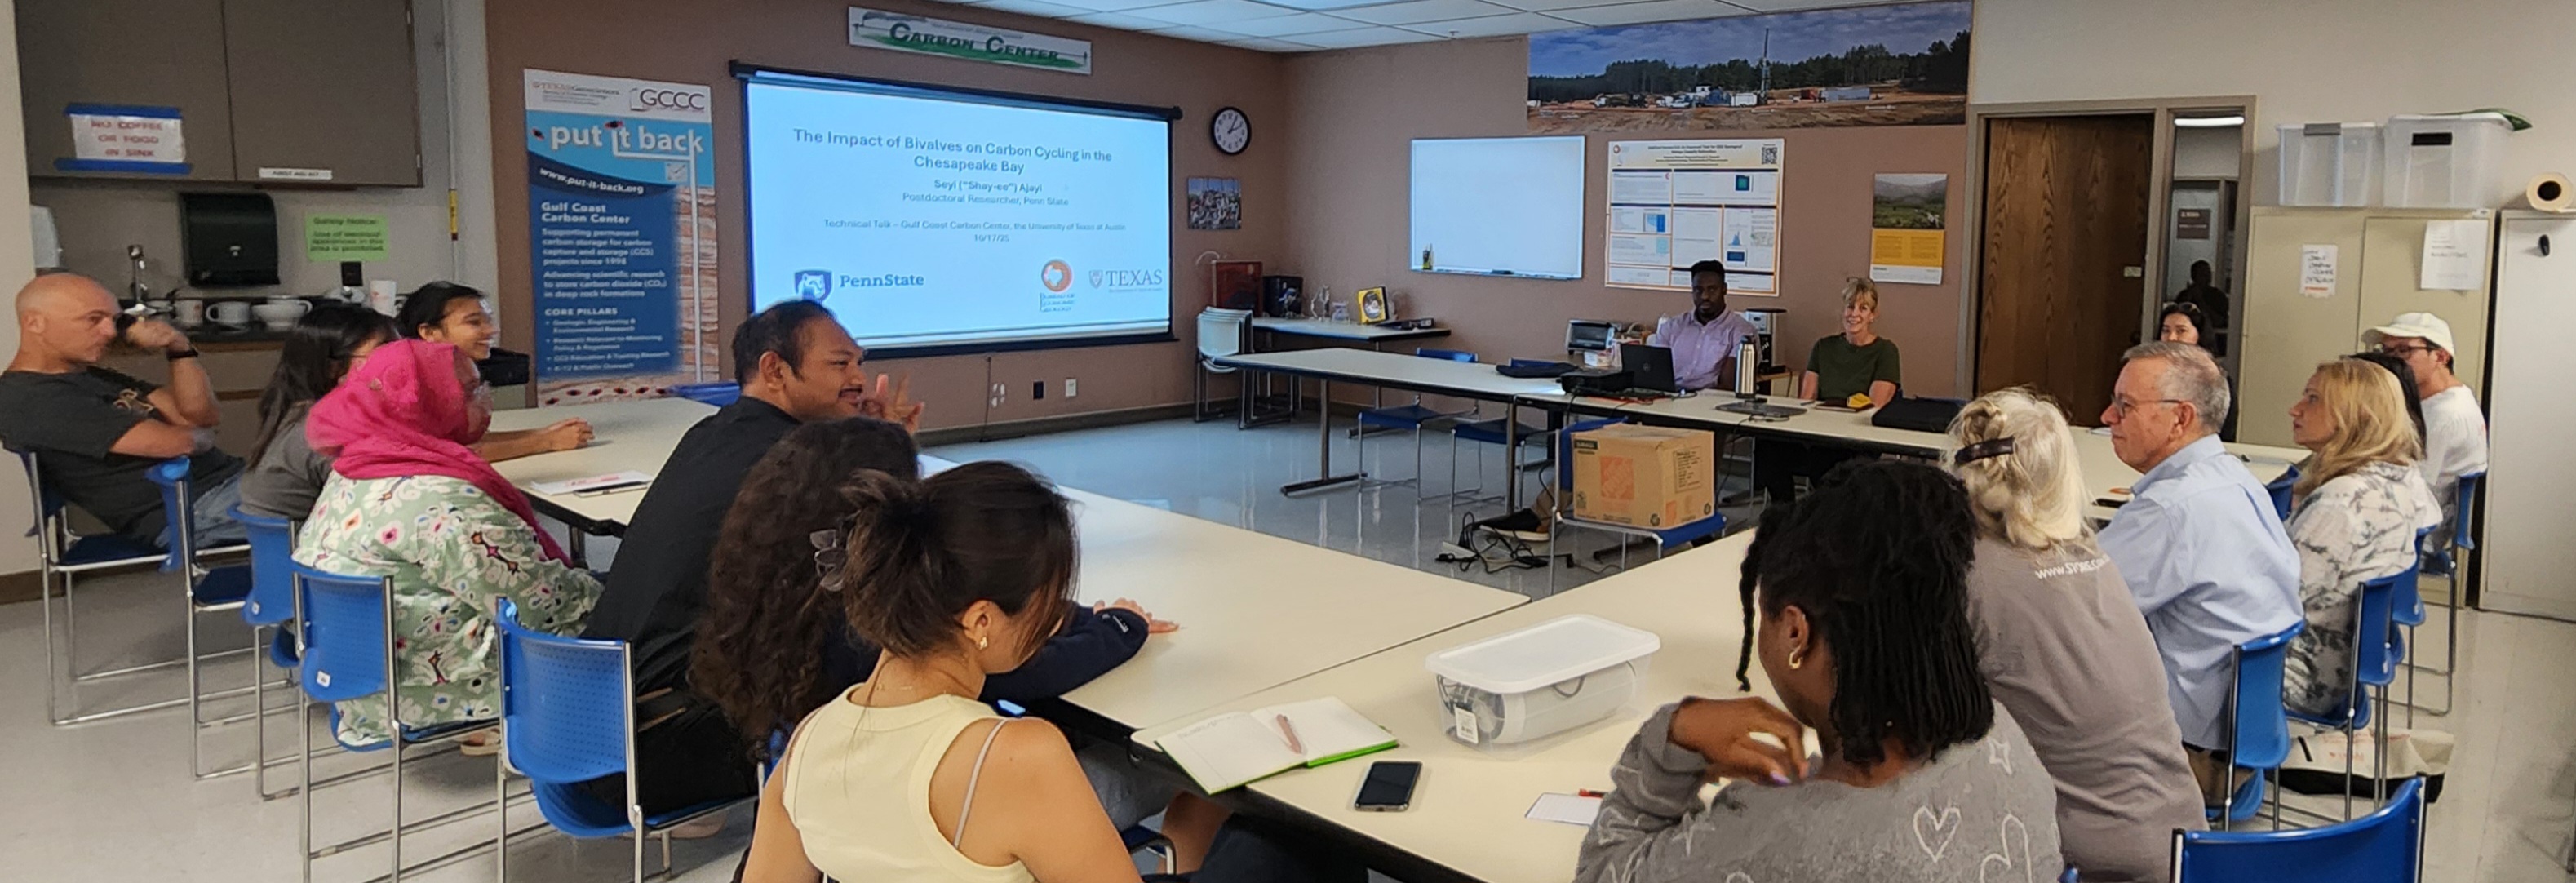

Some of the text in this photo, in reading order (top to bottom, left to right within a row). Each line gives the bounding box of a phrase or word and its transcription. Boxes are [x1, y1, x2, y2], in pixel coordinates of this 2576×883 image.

[889, 23, 973, 49] CARBON
[985, 36, 1059, 60] CENTER
[639, 88, 705, 111] GCCC
[91, 120, 163, 131] NO COFFEE
[97, 134, 159, 144] OR FOOD
[550, 124, 704, 153] put it back
[793, 128, 1112, 162] The Impact of Bivalves on Carbon Cycling in the
[104, 148, 155, 158] IN SINK
[914, 154, 1025, 175] Chesapeake Bay
[539, 166, 645, 195] www.put-it-back.org
[933, 179, 957, 192] Seyi
[1019, 183, 1043, 194] Ajayi
[902, 192, 1069, 206] Postdoctoral Researcher, Penn State
[541, 202, 606, 213] Gulf Coast
[541, 212, 631, 224] Carbon Center
[824, 219, 871, 229] Technical
[874, 219, 891, 229] Talk
[900, 220, 920, 229] Gulf
[922, 220, 948, 229] Coast
[950, 220, 982, 230] Carbon
[1013, 222, 1026, 231] the
[542, 228, 592, 238] Supporting
[839, 273, 924, 288] PennState
[1105, 268, 1163, 286] TEXAS
[544, 307, 619, 317] CORE PILLARS
